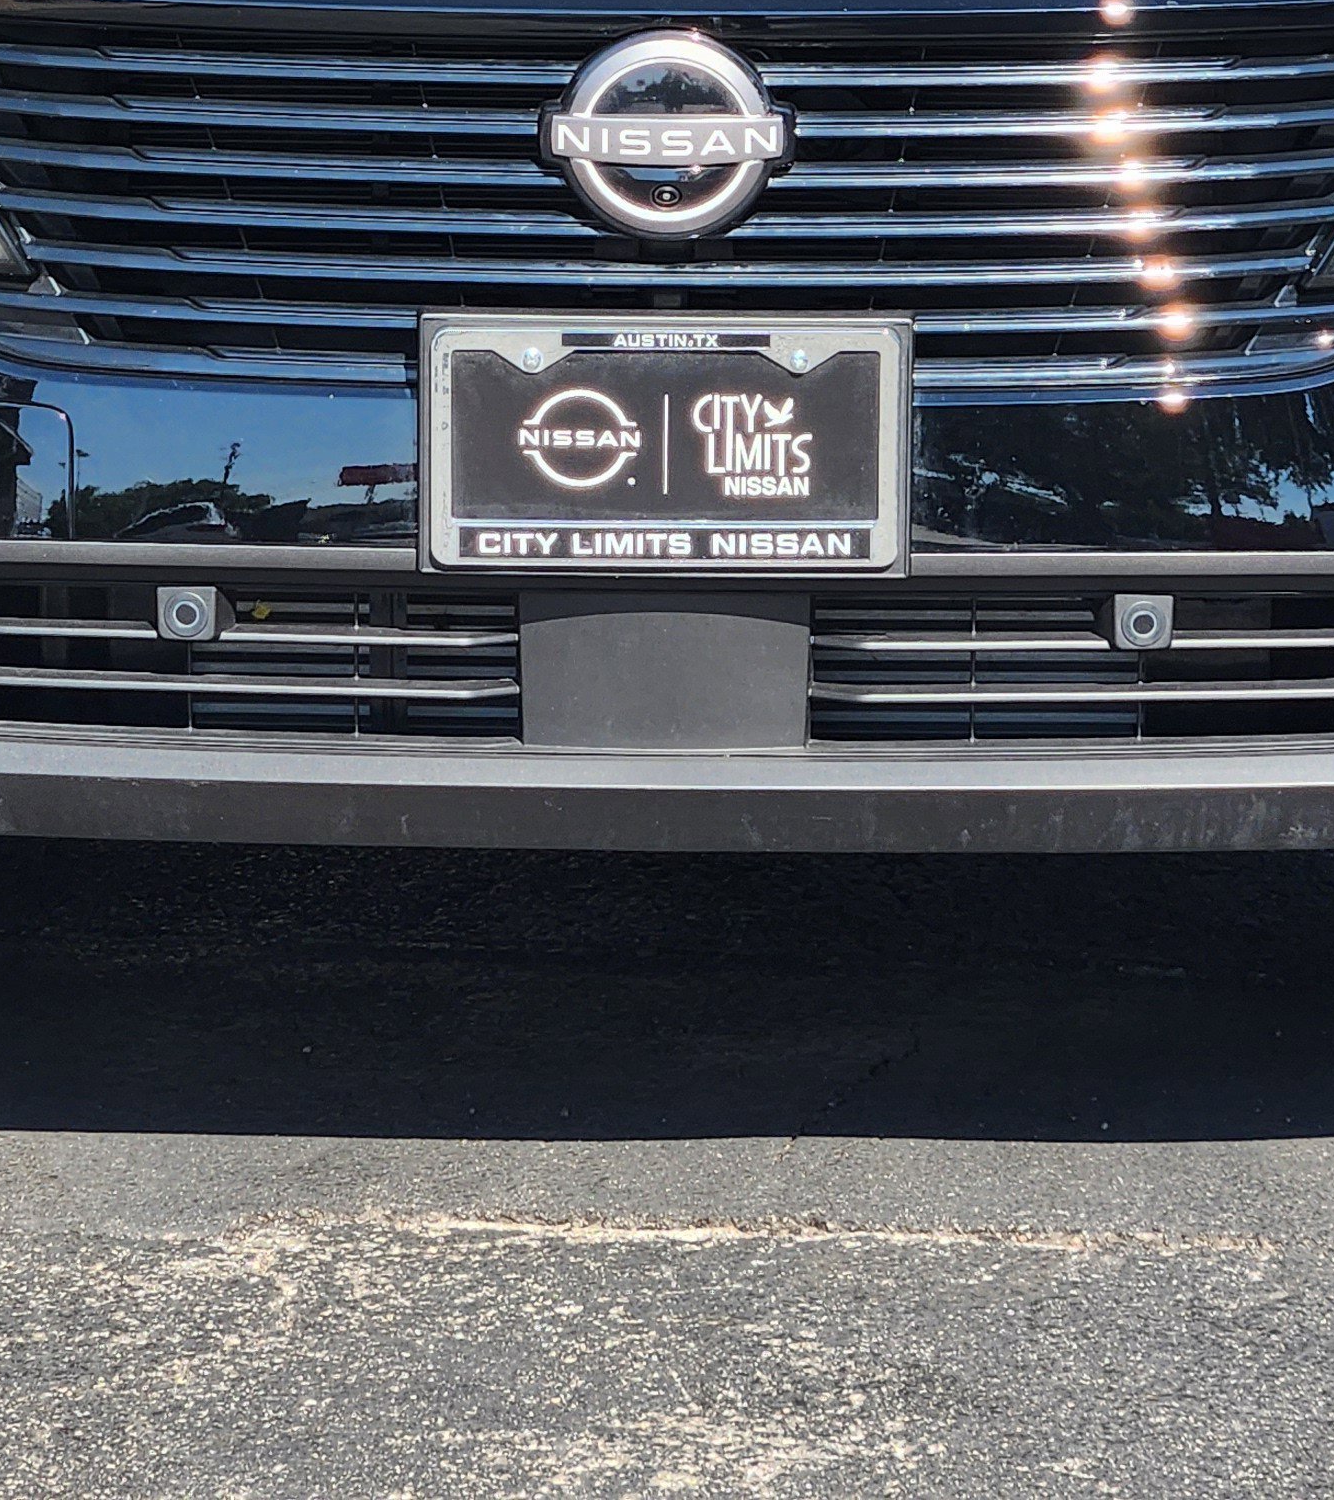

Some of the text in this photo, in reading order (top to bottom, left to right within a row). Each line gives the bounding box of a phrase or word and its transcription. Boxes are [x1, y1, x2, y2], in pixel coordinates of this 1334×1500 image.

[557, 124, 777, 156] NISSAN
[692, 393, 763, 433] CITY
[518, 428, 641, 448] NISSAN
[707, 433, 813, 477] LIMITS
[724, 476, 810, 496] NISSAN
[478, 532, 851, 556] CITY LIMITS NISSAN
